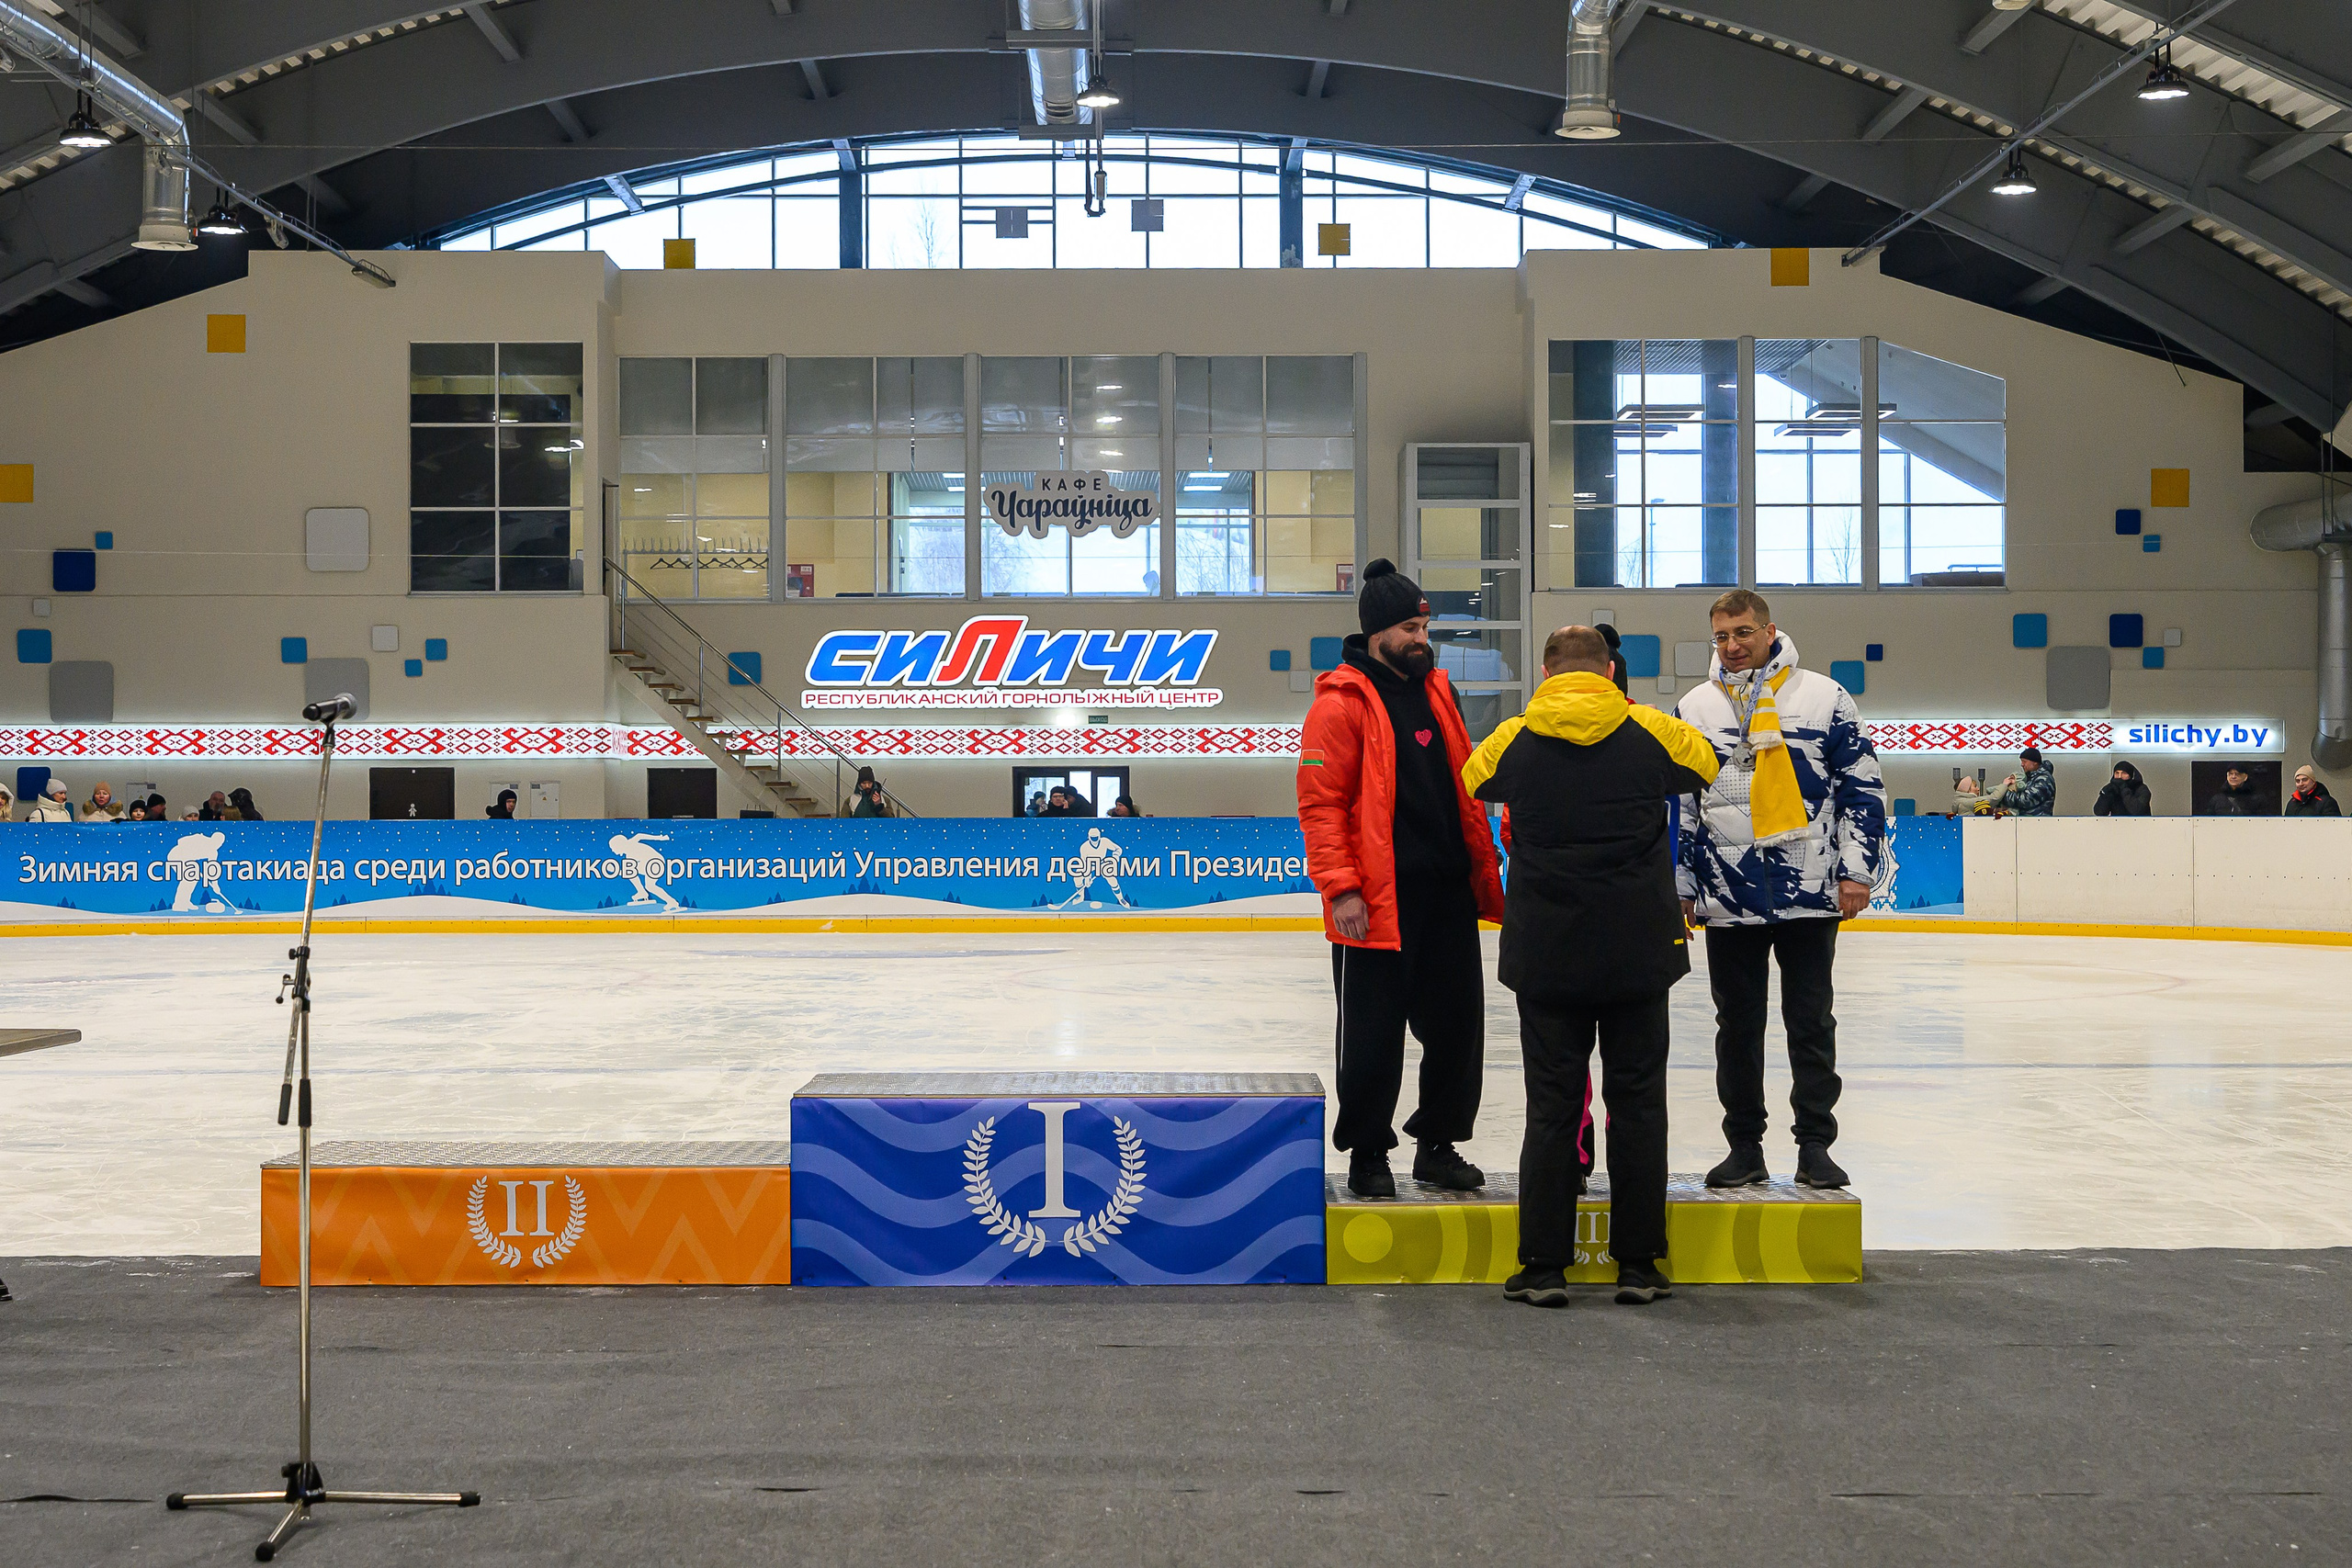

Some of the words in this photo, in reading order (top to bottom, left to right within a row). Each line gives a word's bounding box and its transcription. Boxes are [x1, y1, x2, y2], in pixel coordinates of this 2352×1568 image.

[1042, 478, 1102, 491] КАФЕ
[990, 490, 1153, 532] Чараўніца
[805, 691, 998, 705] РЕСПУБЛИКАНСКИЙ
[1001, 690, 1154, 705] ГОРНОЛЫЖНЫЙ
[1159, 692, 1219, 707] ЦЕНТР
[2129, 724, 2268, 747] silichy.by
[18, 855, 138, 883] Зимняя
[147, 859, 345, 887] спартакиада
[354, 858, 446, 886] среди
[456, 851, 639, 886] работников
[645, 851, 846, 884] организаций
[854, 851, 1039, 885] Управления
[1046, 856, 1160, 883] делами
[1026, 1100, 1081, 1219] I
[499, 1179, 554, 1237] II
